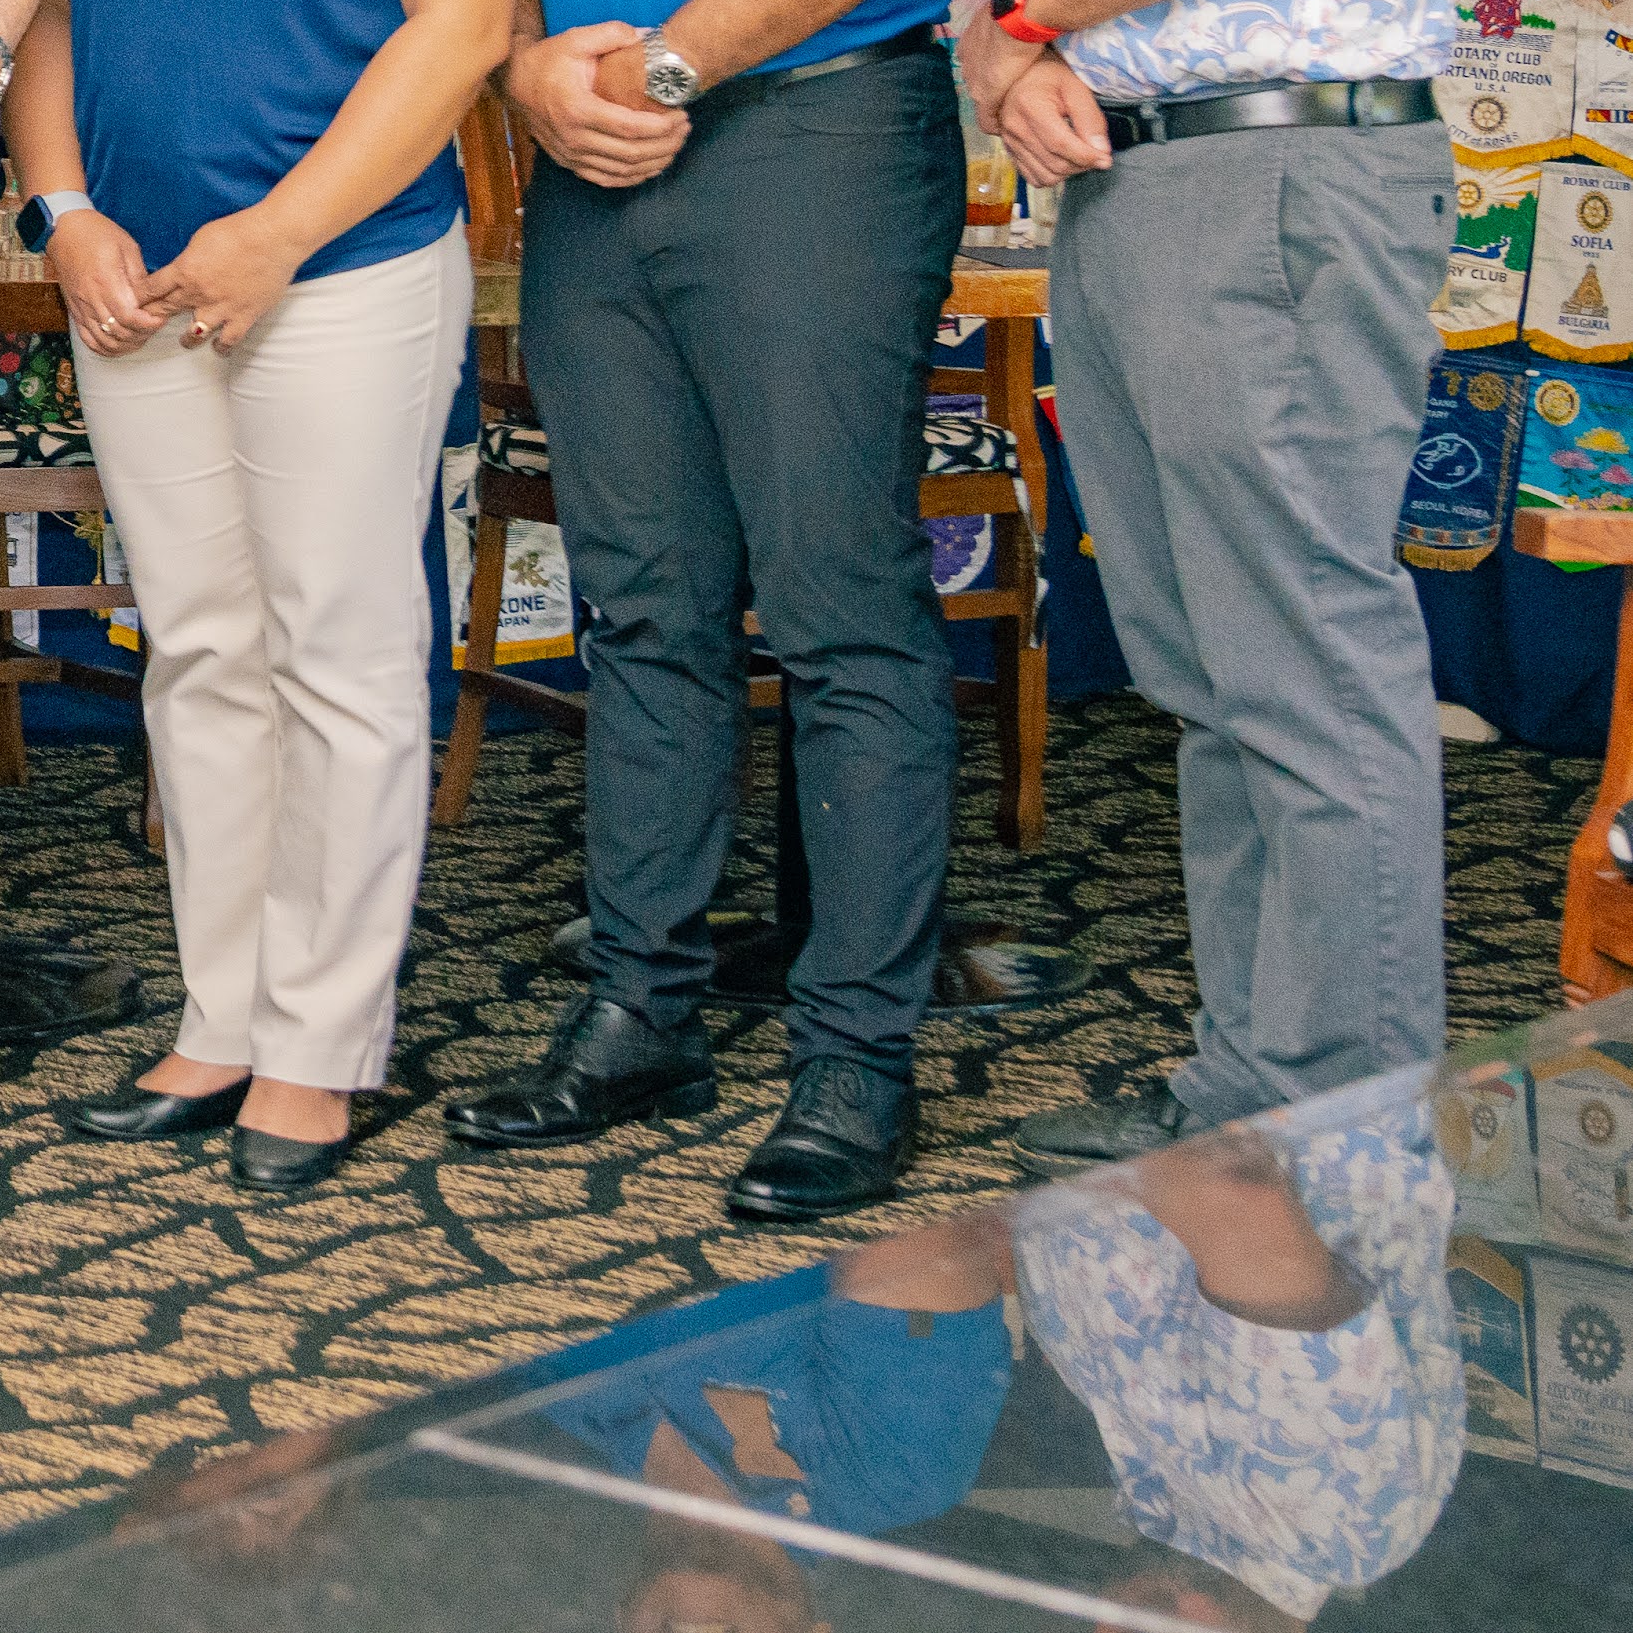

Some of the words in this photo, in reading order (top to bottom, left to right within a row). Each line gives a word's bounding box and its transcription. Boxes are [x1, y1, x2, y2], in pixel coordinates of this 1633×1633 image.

[1506, 51, 1542, 67] CLUB
[1437, 65, 1501, 82] RTLAND,
[1502, 70, 1553, 87] OREGON
[1562, 176, 1601, 189] ROTARY
[1603, 180, 1632, 191] CLUB
[1570, 235, 1614, 251] SOFIA
[1470, 268, 1508, 284] CLUB
[1558, 316, 1611, 331] BULGARIA
